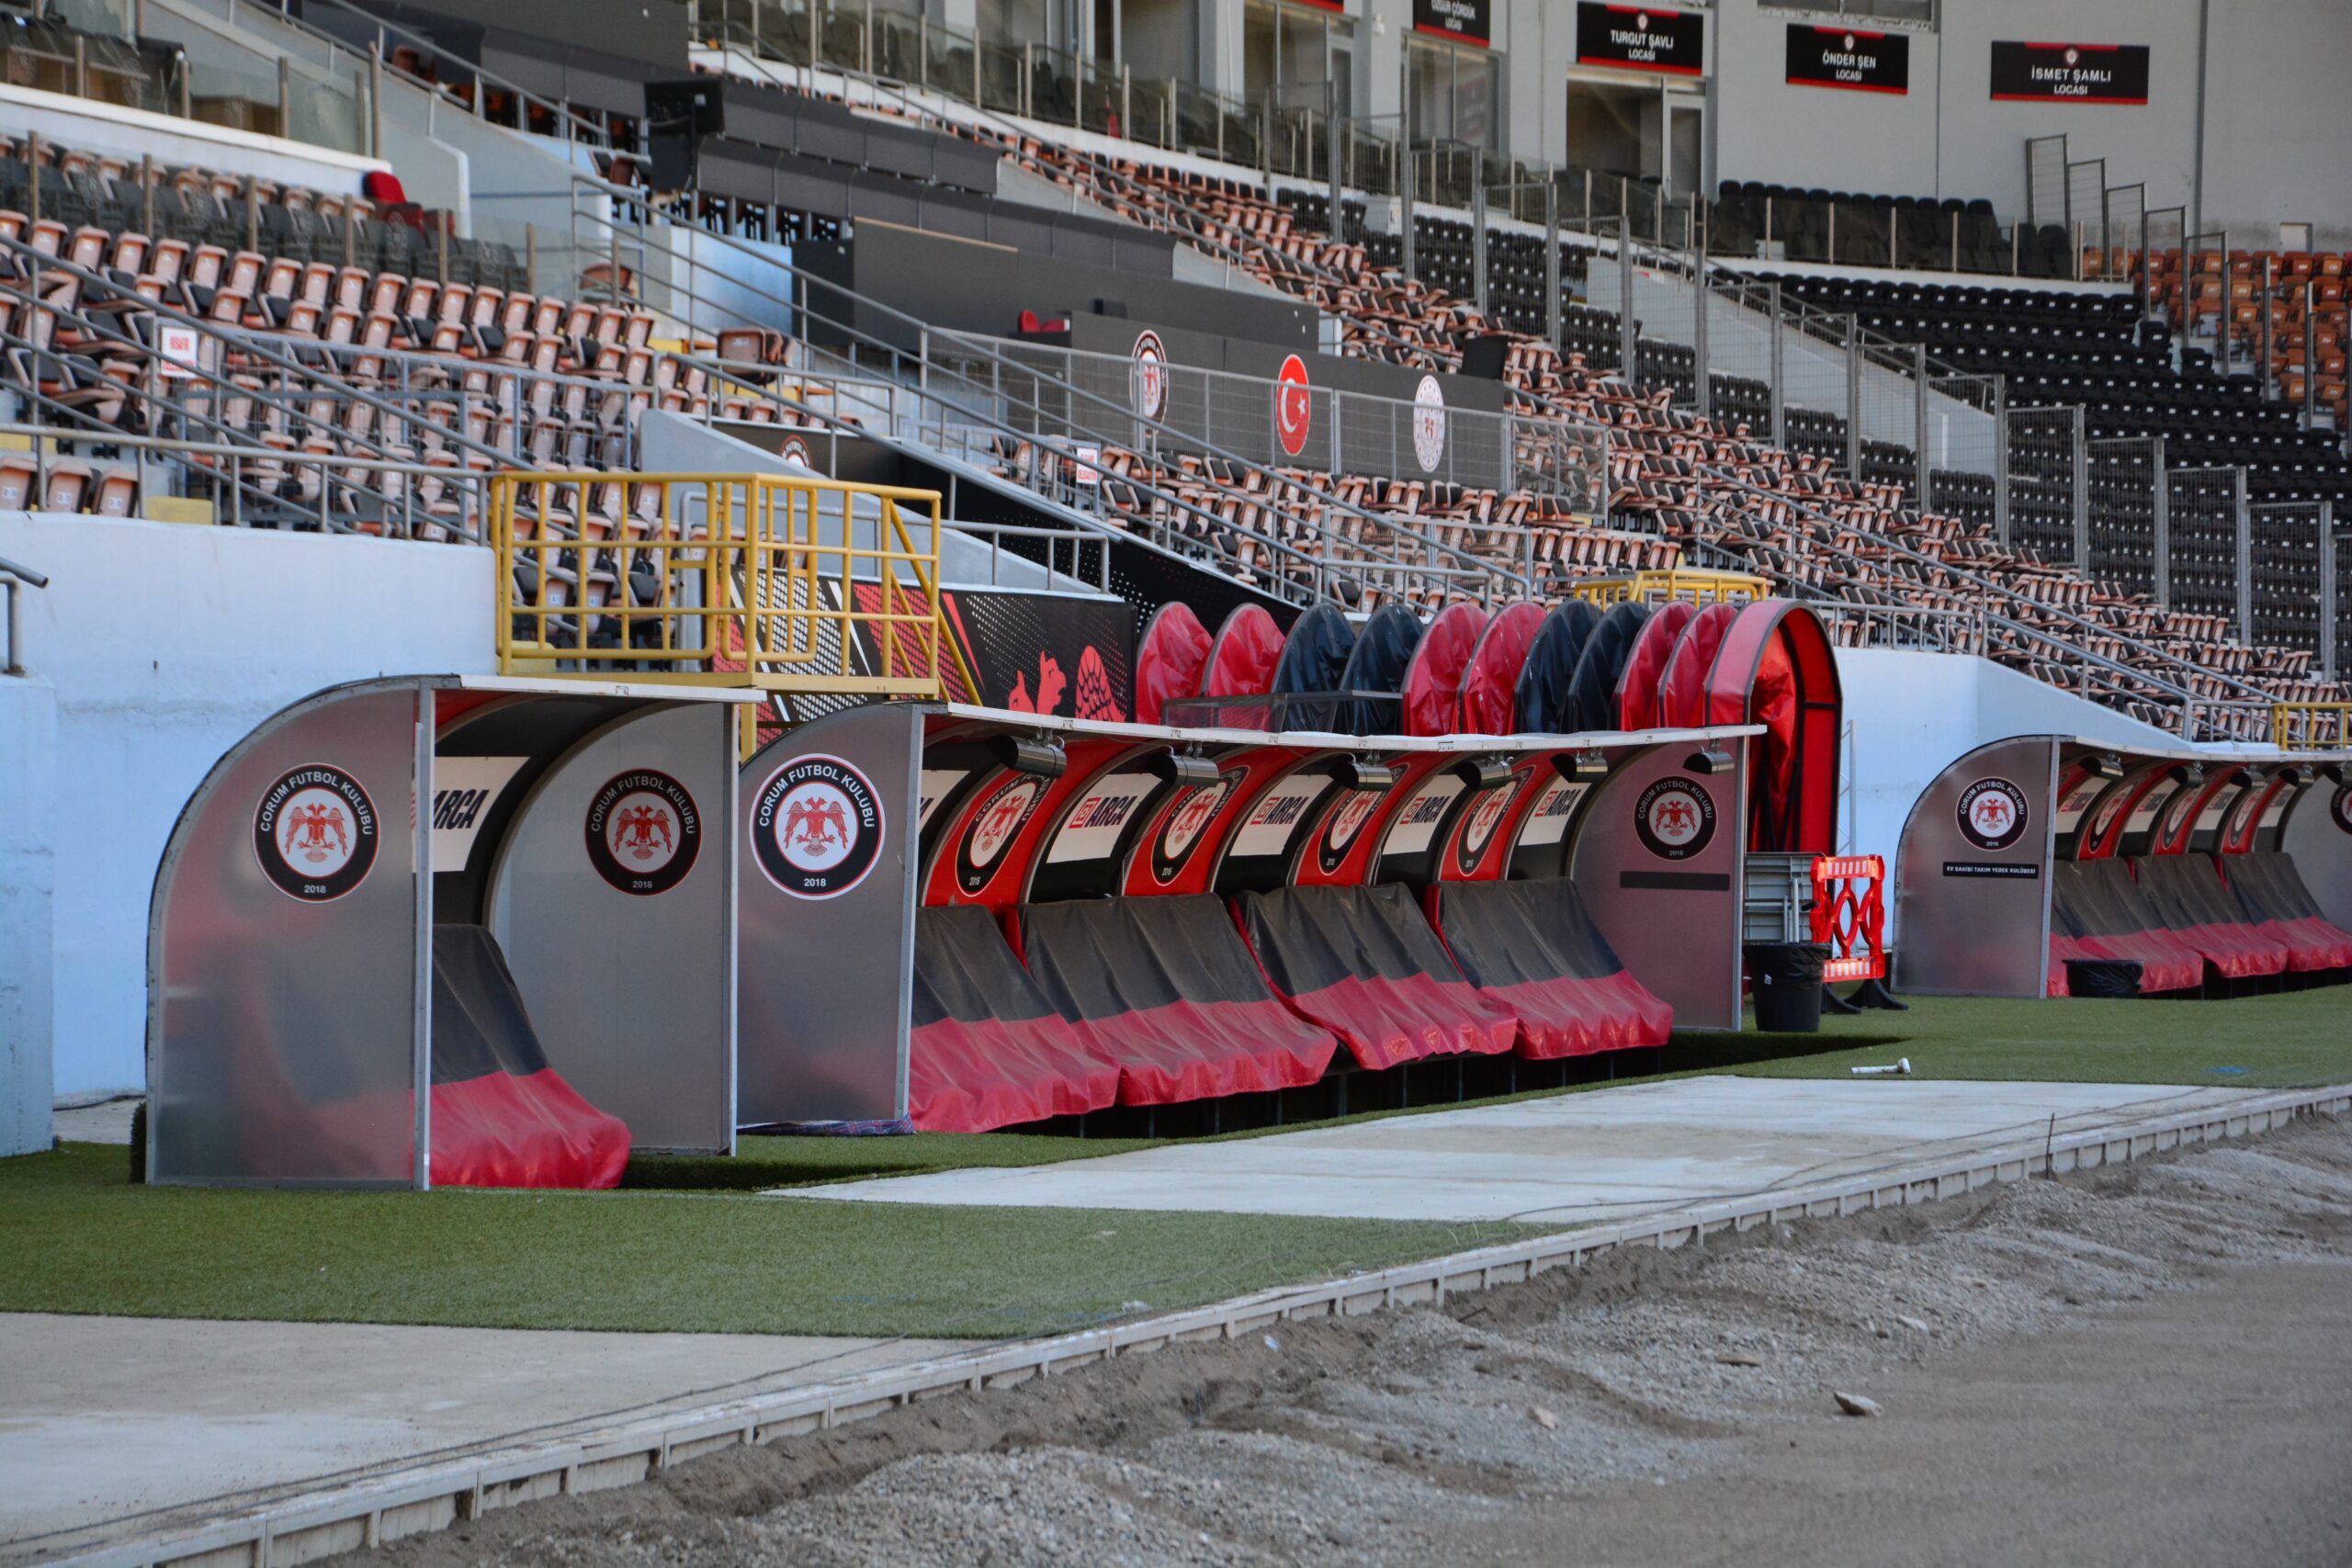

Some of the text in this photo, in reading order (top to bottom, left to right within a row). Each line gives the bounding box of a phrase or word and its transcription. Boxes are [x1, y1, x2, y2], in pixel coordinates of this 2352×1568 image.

[1610, 29, 1646, 46] TURGUT
[1628, 48, 1656, 62] LOCASI
[1822, 49, 1876, 69] ÖNDER ŞEN
[1836, 69, 1862, 82] LOCASI
[2031, 64, 2111, 84] İSMET ŞAMLI
[2053, 84, 2088, 96] LOCASI
[288, 771, 338, 788] FUTBOL
[787, 764, 840, 783] FUTBOL
[616, 775, 664, 792] FUTBOL
[1656, 780, 1690, 792] FUTBOL
[1975, 781, 2006, 791] FUTBOL
[1084, 795, 1138, 828] ARCA
[1263, 796, 1309, 825] ARCA
[1410, 795, 1451, 824] ARCA
[304, 885, 327, 894] 2018
[632, 880, 653, 889] 2018
[804, 878, 827, 887] 2018
